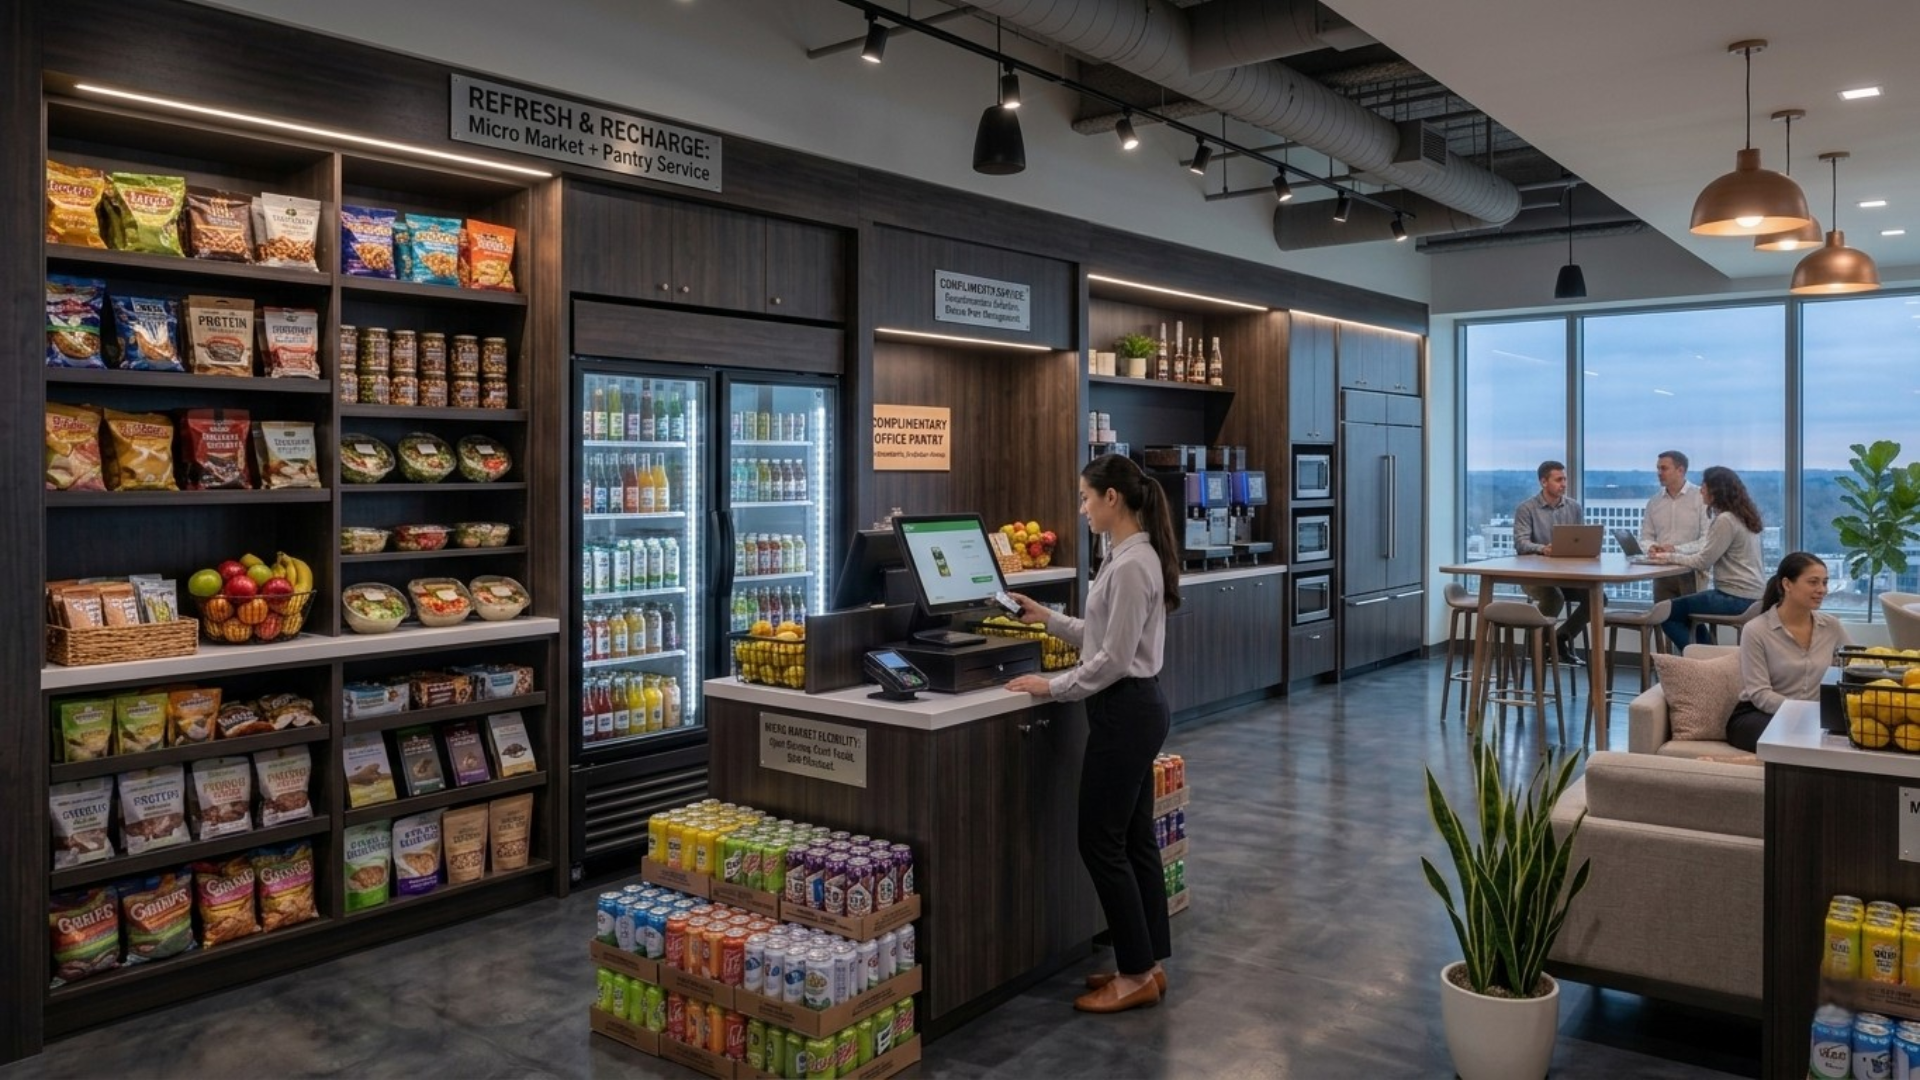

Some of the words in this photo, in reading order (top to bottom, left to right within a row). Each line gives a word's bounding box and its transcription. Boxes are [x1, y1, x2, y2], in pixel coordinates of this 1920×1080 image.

[468, 85, 572, 130] REFRESH
[579, 111, 594, 135] &
[601, 115, 710, 160] RECHARGE:
[469, 115, 520, 142] Micro
[525, 128, 584, 156] Market
[588, 144, 598, 155] +
[603, 143, 652, 173] Pantry
[657, 155, 710, 181] Service
[874, 432, 906, 445] OFFICE
